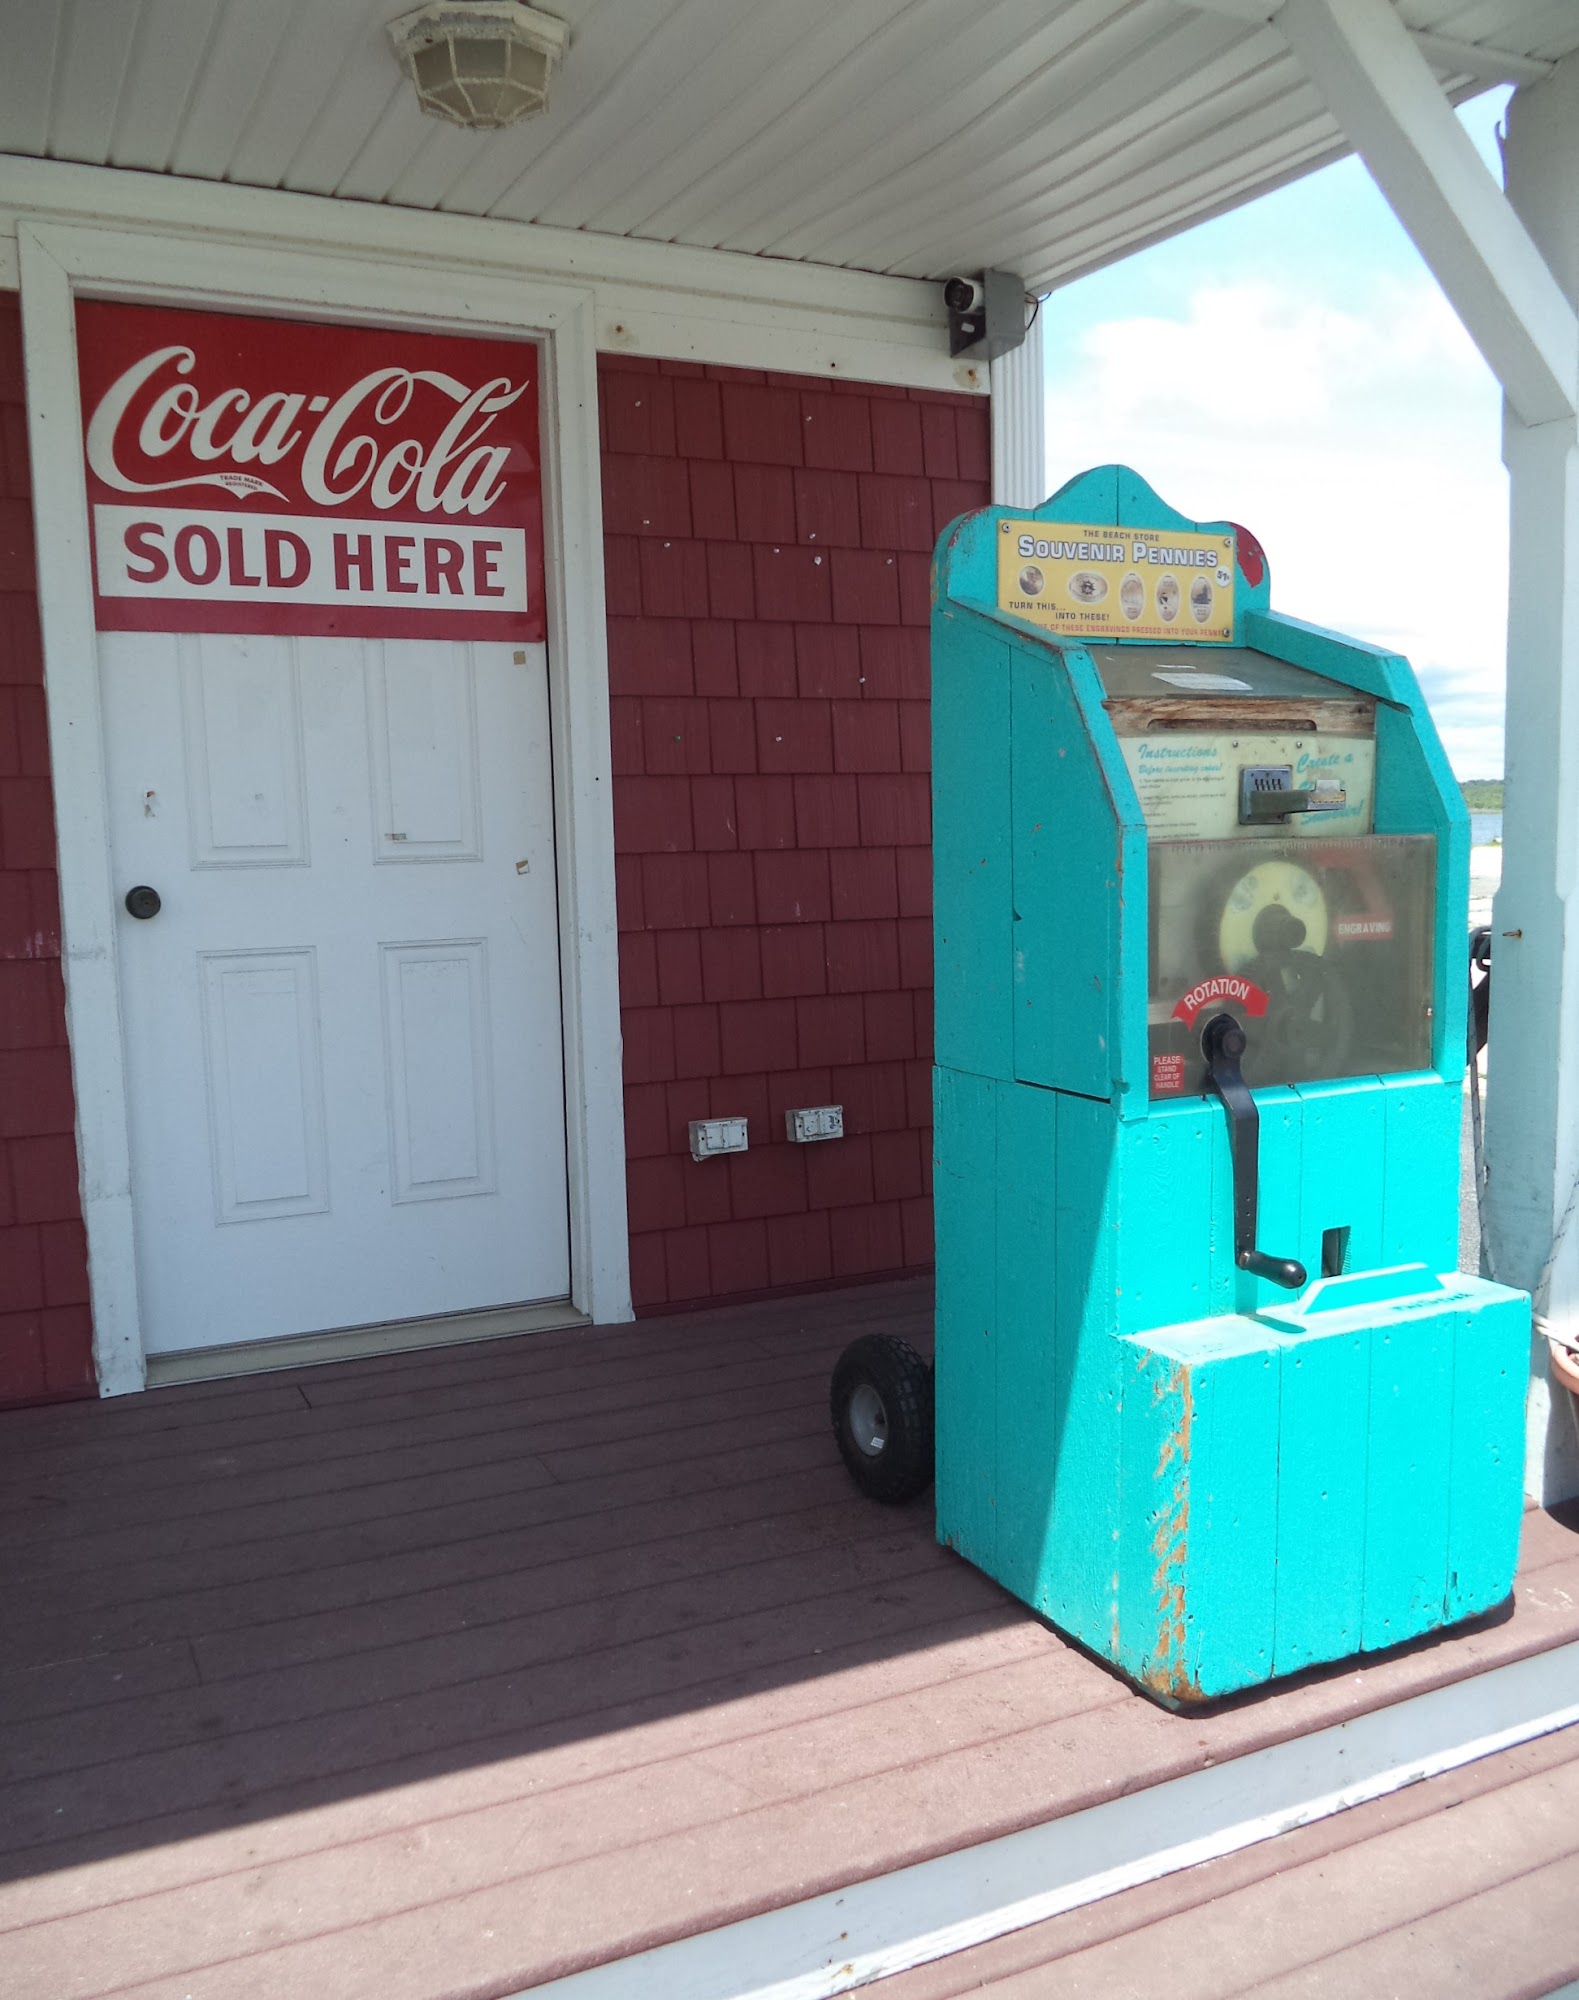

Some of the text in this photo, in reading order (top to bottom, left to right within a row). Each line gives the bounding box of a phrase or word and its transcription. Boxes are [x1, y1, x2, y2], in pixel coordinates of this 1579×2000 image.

[87, 345, 529, 515] Coca-Cola
[244, 477, 263, 487] MARK
[1083, 530, 1160, 542] THE BEACH STORE
[1018, 535, 1218, 567] SOUVENIR PENNIES
[123, 522, 506, 597] SOLD HERE
[1009, 601, 1066, 611] TURN THIS...
[1055, 612, 1110, 621] INTO THESE!
[1062, 624, 1084, 632] THESE
[1086, 625, 1130, 633] ENGRAVINGS
[1132, 626, 1161, 634] PRESSED
[1164, 627, 1179, 635] INTO
[1138, 743, 1217, 759] Instructions
[1297, 753, 1340, 773] Create
[1138, 764, 1163, 775] Before
[1338, 921, 1392, 935] ENGRAVING
[1184, 978, 1250, 1010] ROTATION
[1153, 1056, 1181, 1065] PLEASE
[1157, 1065, 1177, 1073] STAND
[1154, 1073, 1171, 1081] CLEAR
[1155, 1081, 1179, 1089] HANDLE
